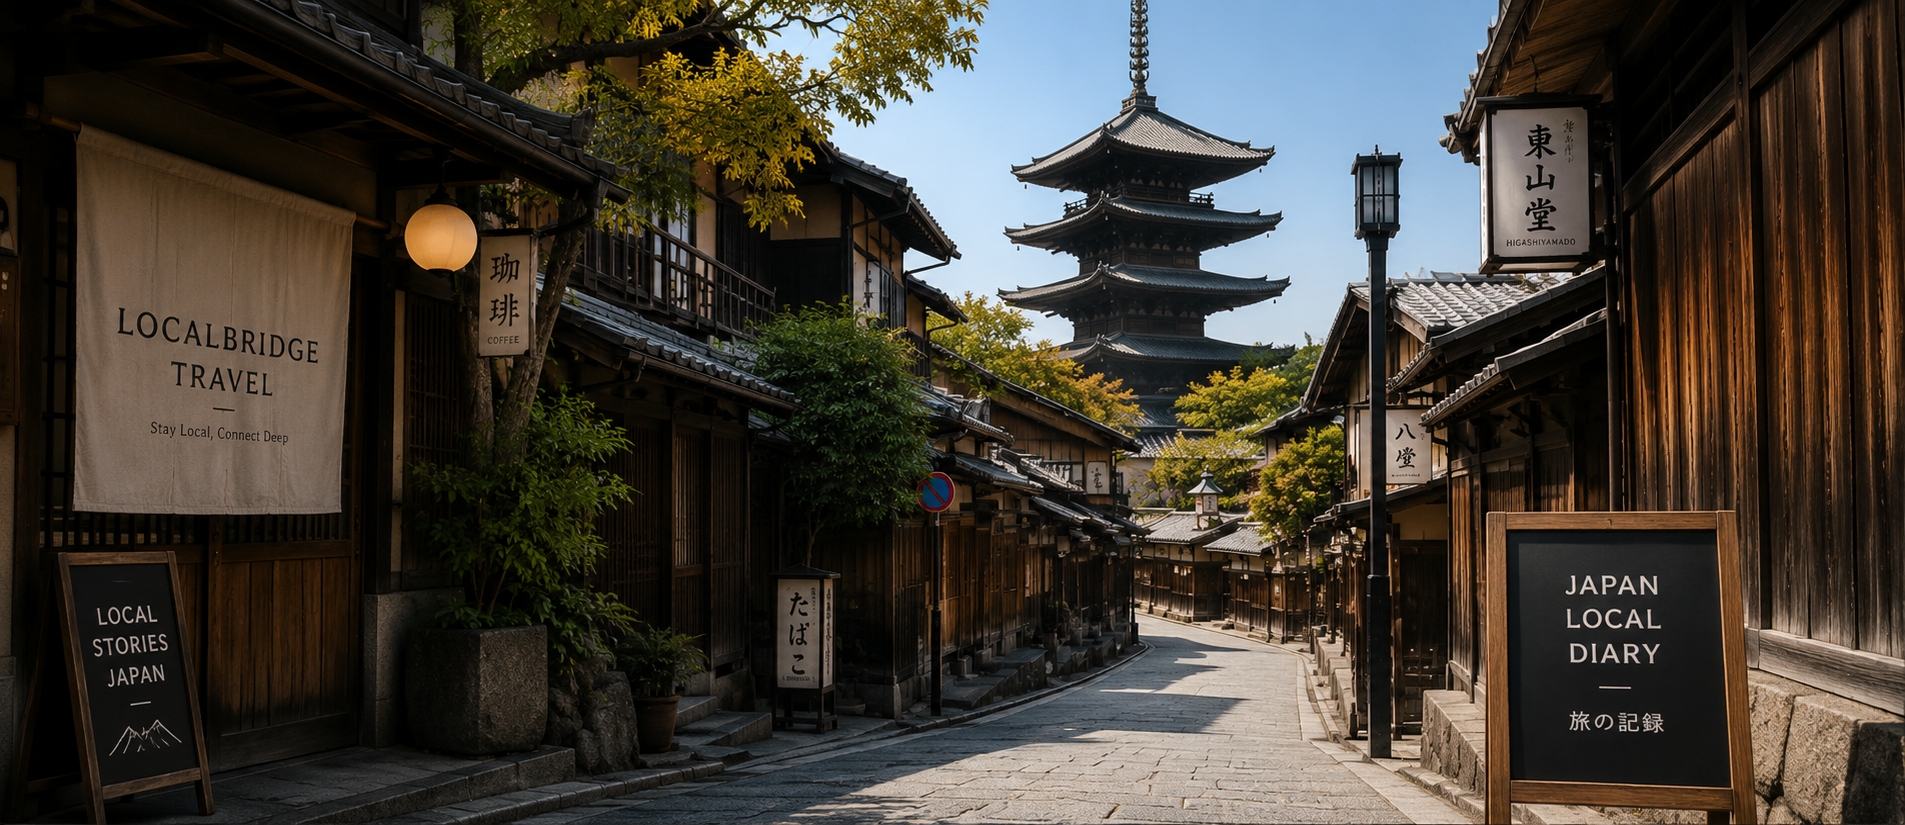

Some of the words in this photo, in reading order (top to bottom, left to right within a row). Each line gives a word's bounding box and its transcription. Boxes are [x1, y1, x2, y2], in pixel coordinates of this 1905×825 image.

[1524, 124, 1557, 232] 東山堂
[1506, 237, 1576, 247] HIGASHIYAMADO
[489, 253, 520, 327] 珈琲
[117, 307, 319, 363] LOCALBRIDGE
[487, 335, 519, 344] COFFEE
[171, 361, 273, 396] TRAVEL
[150, 421, 176, 438] Stay
[180, 424, 214, 441] Local,
[217, 427, 260, 442] Connect
[264, 430, 289, 445] Deep
[1565, 575, 1659, 596] JAPAN
[96, 605, 158, 626] LOCAL
[1566, 608, 1662, 630] LOCAL
[92, 633, 169, 657] STORIES
[789, 592, 810, 675] たばこ
[1569, 643, 1661, 664] DIARY
[107, 664, 165, 688] JAPAN
[1569, 710, 1664, 734] 旅の記録
